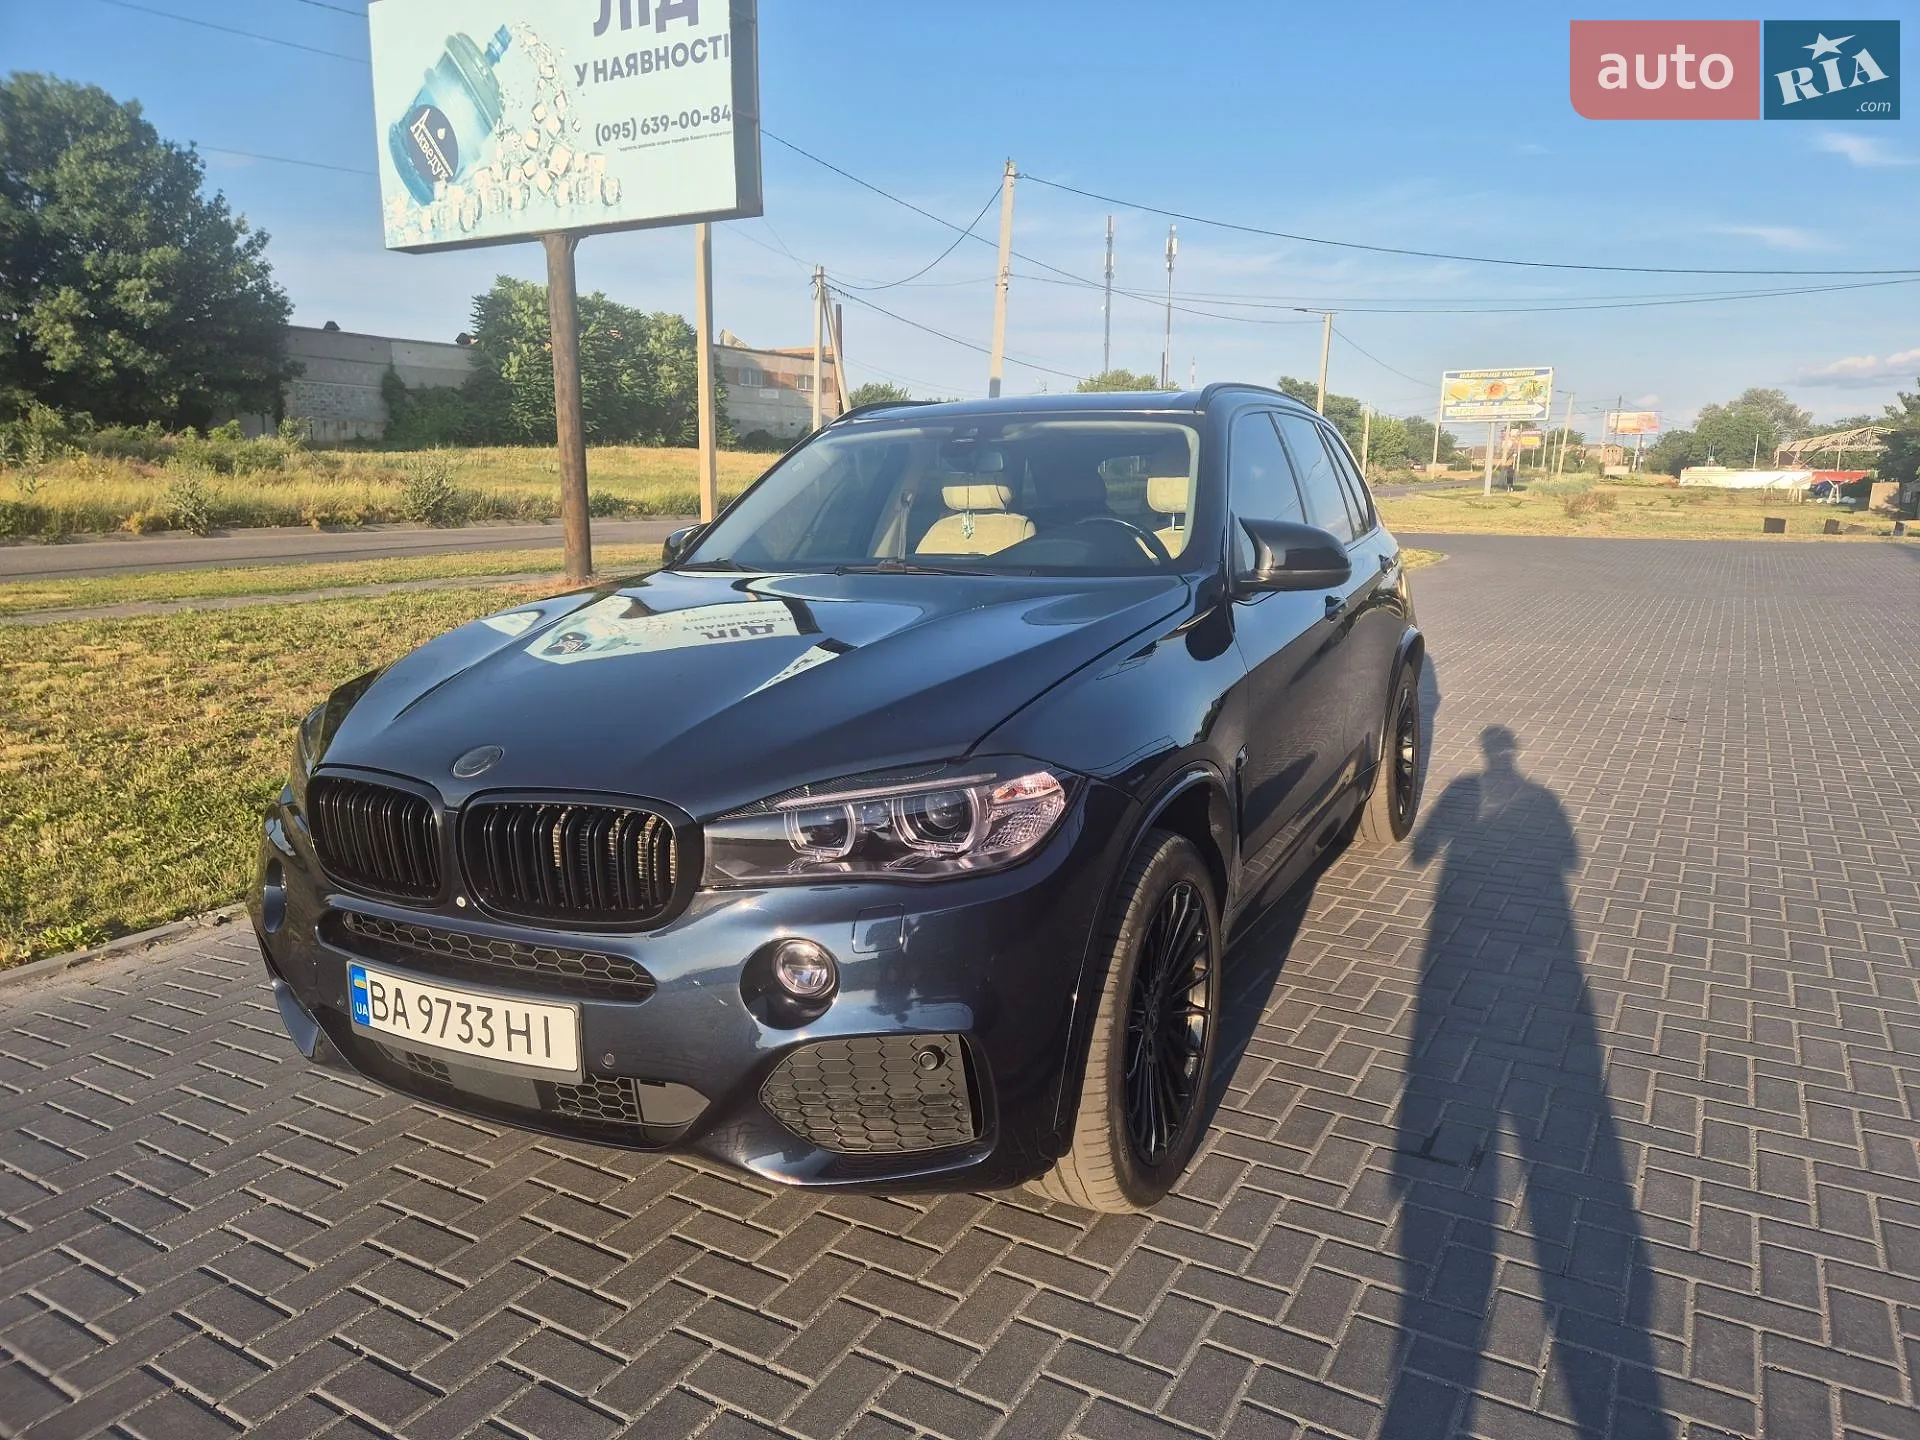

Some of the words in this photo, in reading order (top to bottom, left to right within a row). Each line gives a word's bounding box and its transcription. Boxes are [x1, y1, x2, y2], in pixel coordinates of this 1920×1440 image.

[574, 62, 588, 87] У
[593, 33, 730, 83] НАЯВНОСТІ
[595, 117, 637, 146] (095)
[640, 104, 731, 136] 639-00-84
[356, 1001, 369, 1016] UA
[370, 980, 410, 1029] BA
[417, 994, 495, 1048] 9733
[505, 1010, 551, 1058] HI
